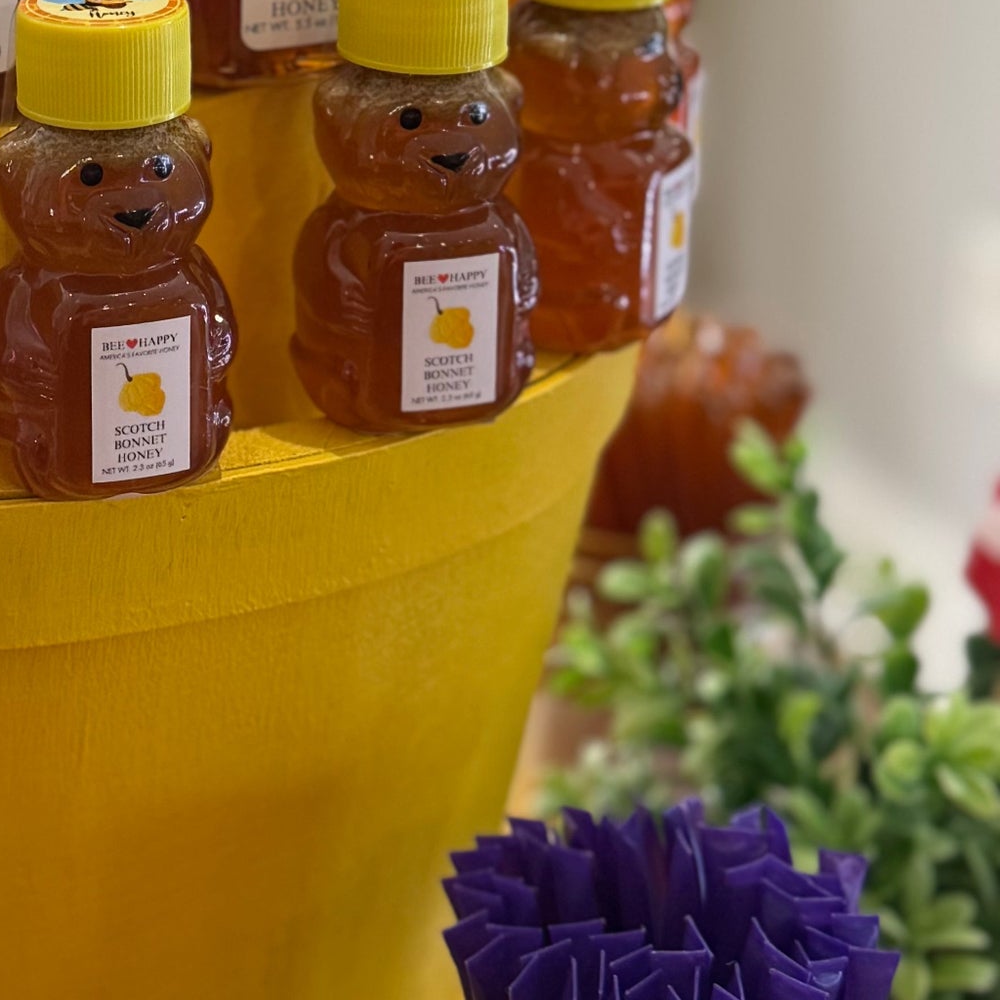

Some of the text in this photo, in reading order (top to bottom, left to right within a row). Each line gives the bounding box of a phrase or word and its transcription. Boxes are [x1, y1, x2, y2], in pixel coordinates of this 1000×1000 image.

[414, 269, 488, 285] BEE HAPPY
[102, 333, 178, 351] BEE HAPPY
[424, 353, 473, 368] SCOTCH
[424, 366, 474, 381] BONNET
[426, 379, 472, 394] HONEY
[114, 420, 166, 437] SCOTCH
[114, 433, 167, 450] BONNET
[118, 448, 163, 463] HONEY
